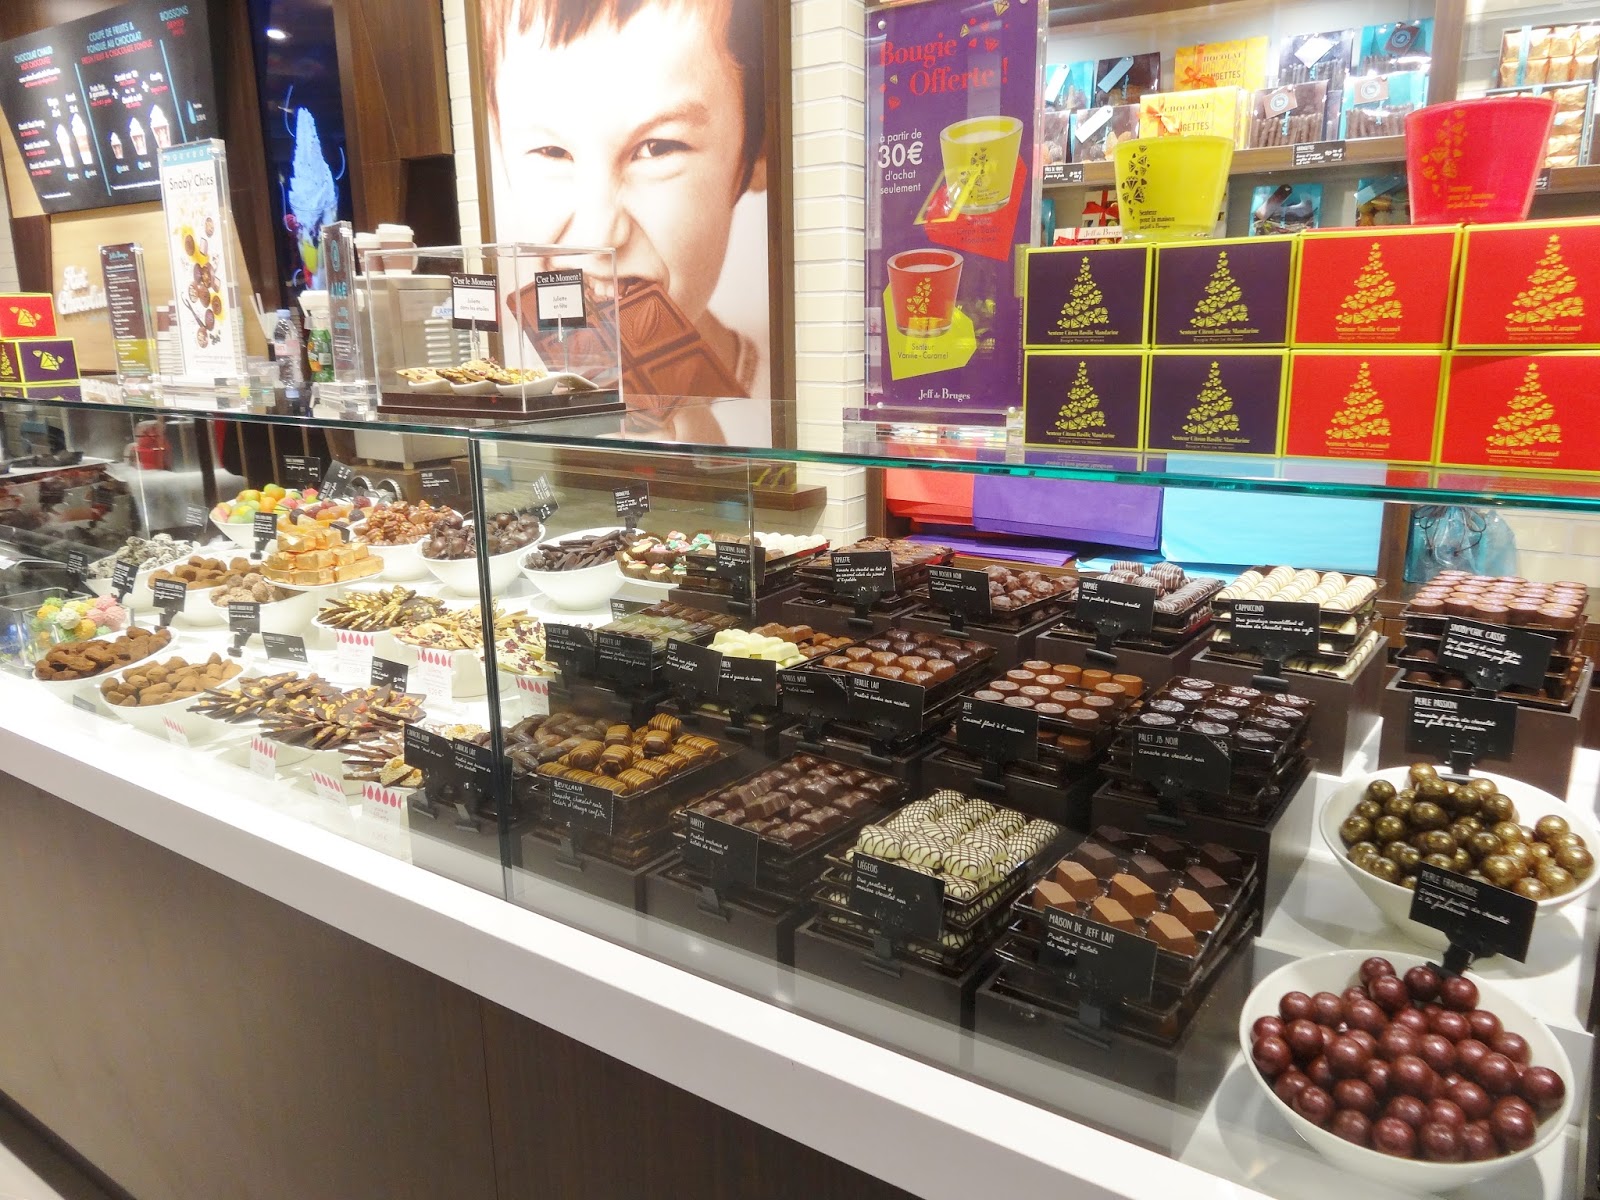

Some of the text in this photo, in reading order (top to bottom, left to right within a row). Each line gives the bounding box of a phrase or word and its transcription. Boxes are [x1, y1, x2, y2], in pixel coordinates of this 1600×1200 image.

[160, 5, 188, 21] BOISSONS
[879, 32, 958, 69] Bougie
[910, 66, 994, 96] Offerte
[1164, 103, 1210, 112] CHOCOLAT
[880, 128, 922, 145] à partir de
[878, 141, 924, 168] 30€
[885, 170, 916, 180] d'achat
[170, 175, 192, 192] Snoby
[193, 174, 214, 188] Chics
[880, 182, 921, 194] seulement
[918, 389, 934, 400] Jeff
[942, 388, 970, 402] Bruges
[1234, 604, 1264, 612] CAPPUCCINO
[1485, 632, 1508, 642] CASSIS
[870, 680, 880, 690] LAIT
[962, 702, 972, 710] JEFF
[1414, 696, 1458, 709] PERLE PASSION
[1138, 732, 1179, 746] PALET JB NOIR
[1138, 748, 1160, 757] Ganache
[858, 860, 878, 874] LIÉGEOIS
[866, 881, 886, 890] praliné
[876, 890, 896, 900] chocolat
[1048, 914, 1115, 944] MAISON DE JEFF LAIT
[1048, 932, 1070, 944] Praliné
[1056, 945, 1078, 956] nougat
